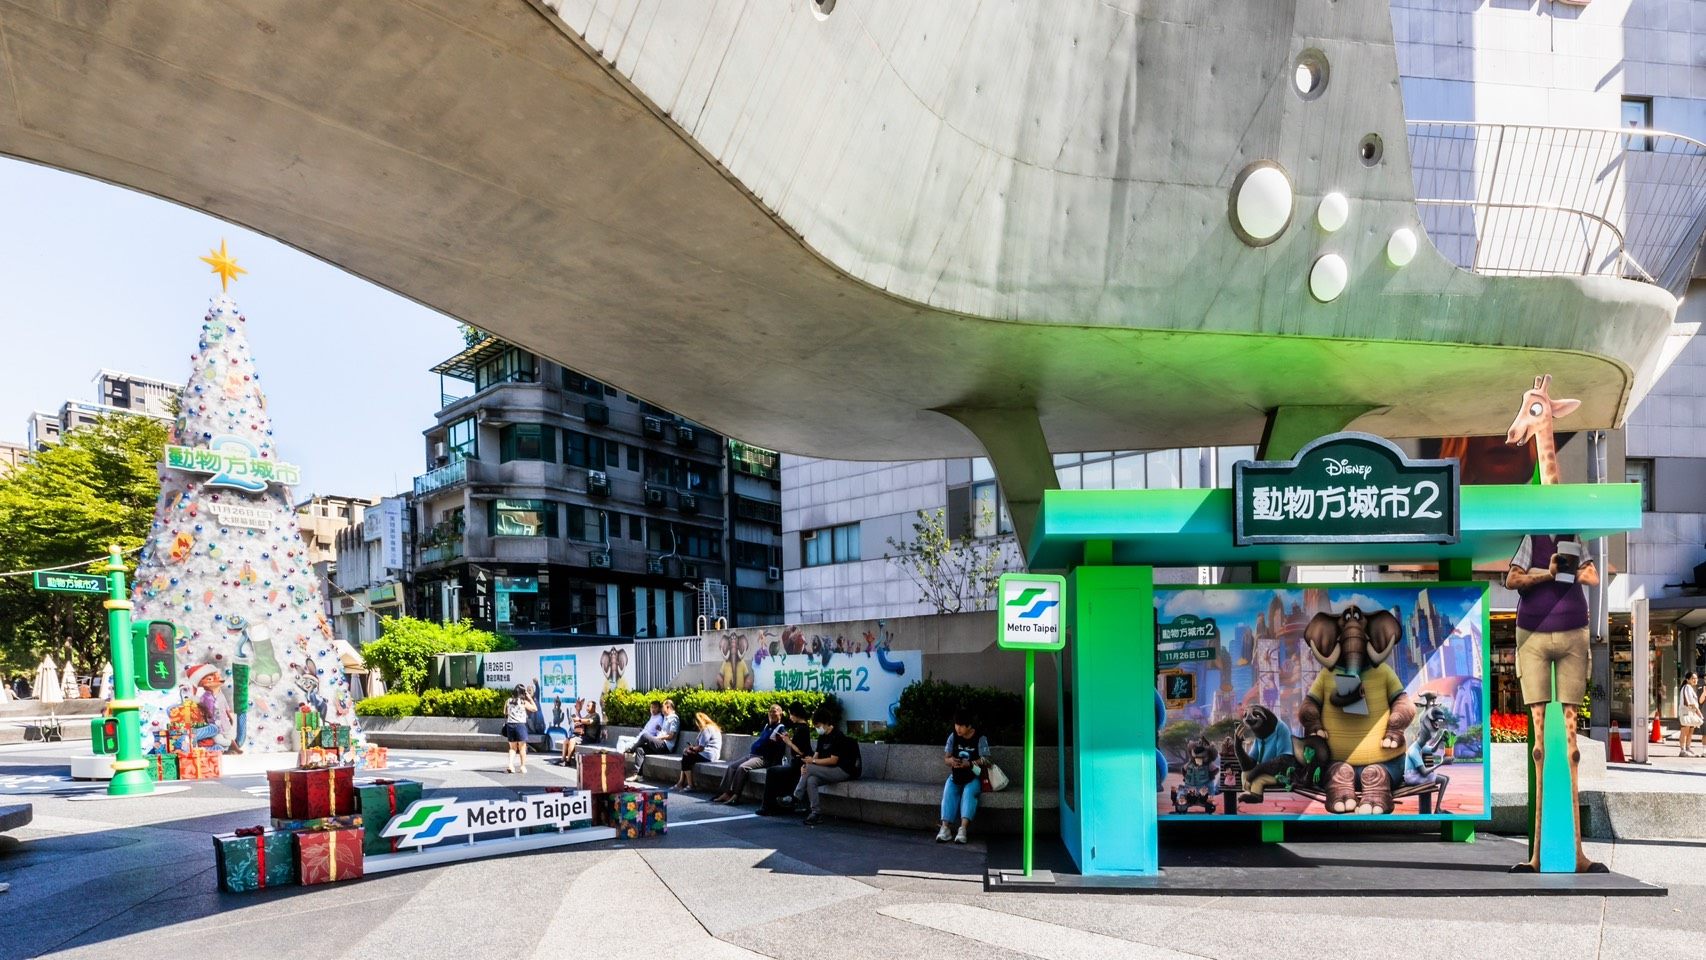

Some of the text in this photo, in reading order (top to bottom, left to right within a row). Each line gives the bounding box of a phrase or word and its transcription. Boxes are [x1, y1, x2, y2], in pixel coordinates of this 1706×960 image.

[168, 446, 298, 483] 動物方城市
[1322, 457, 1372, 480] Disney
[1252, 480, 1443, 520] 動物方城市2
[476, 571, 487, 618] ANTI
[1007, 623, 1057, 634] Metro Taipei
[1162, 623, 1215, 639] 動物方城市2
[1165, 650, 1209, 661] 11月26日(三)
[467, 796, 587, 828] Metro Taipei
